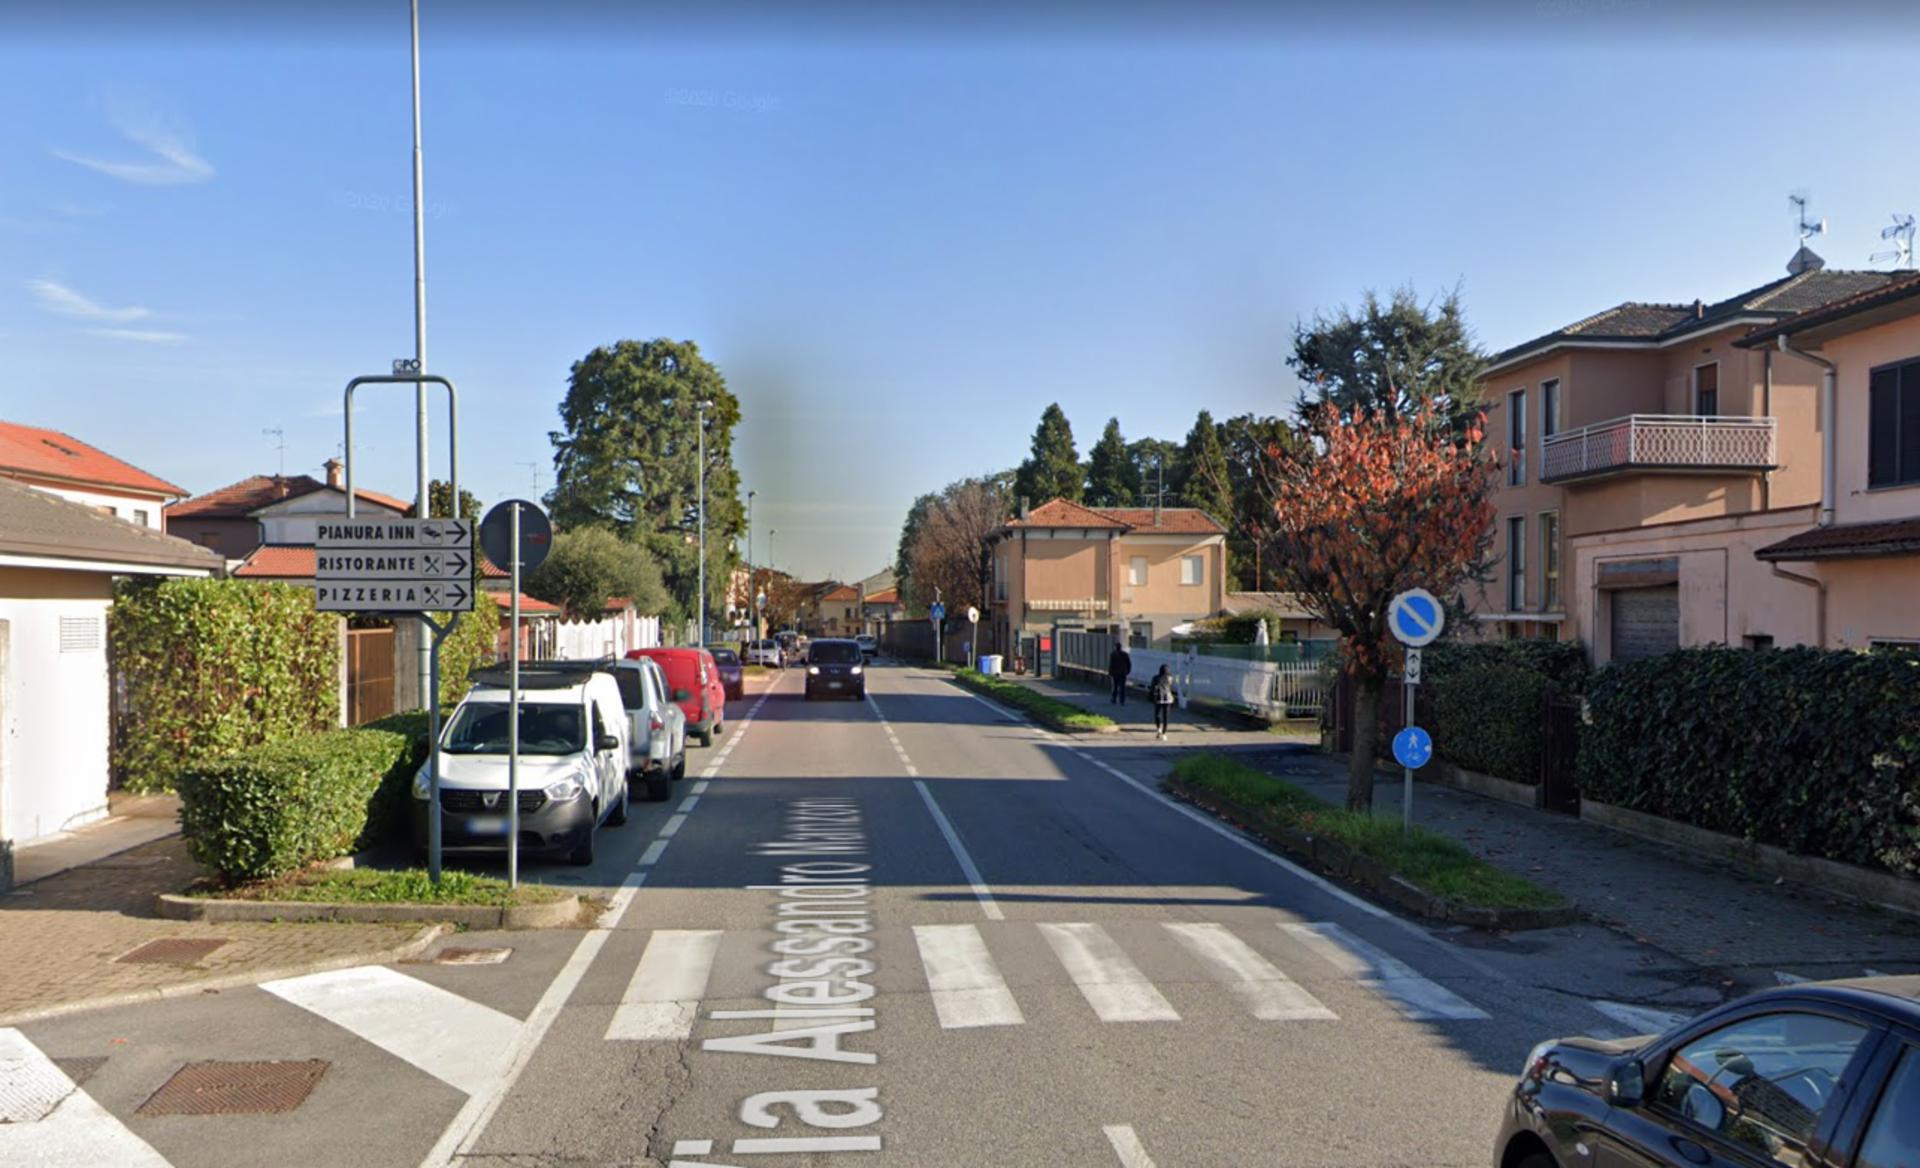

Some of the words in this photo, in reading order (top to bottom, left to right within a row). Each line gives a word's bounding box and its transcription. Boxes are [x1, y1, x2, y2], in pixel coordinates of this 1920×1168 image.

[318, 525, 384, 539] PIANURA
[388, 525, 414, 539] INN
[318, 557, 415, 570] RISTORANTE
[319, 588, 415, 601] PIZZERIA
